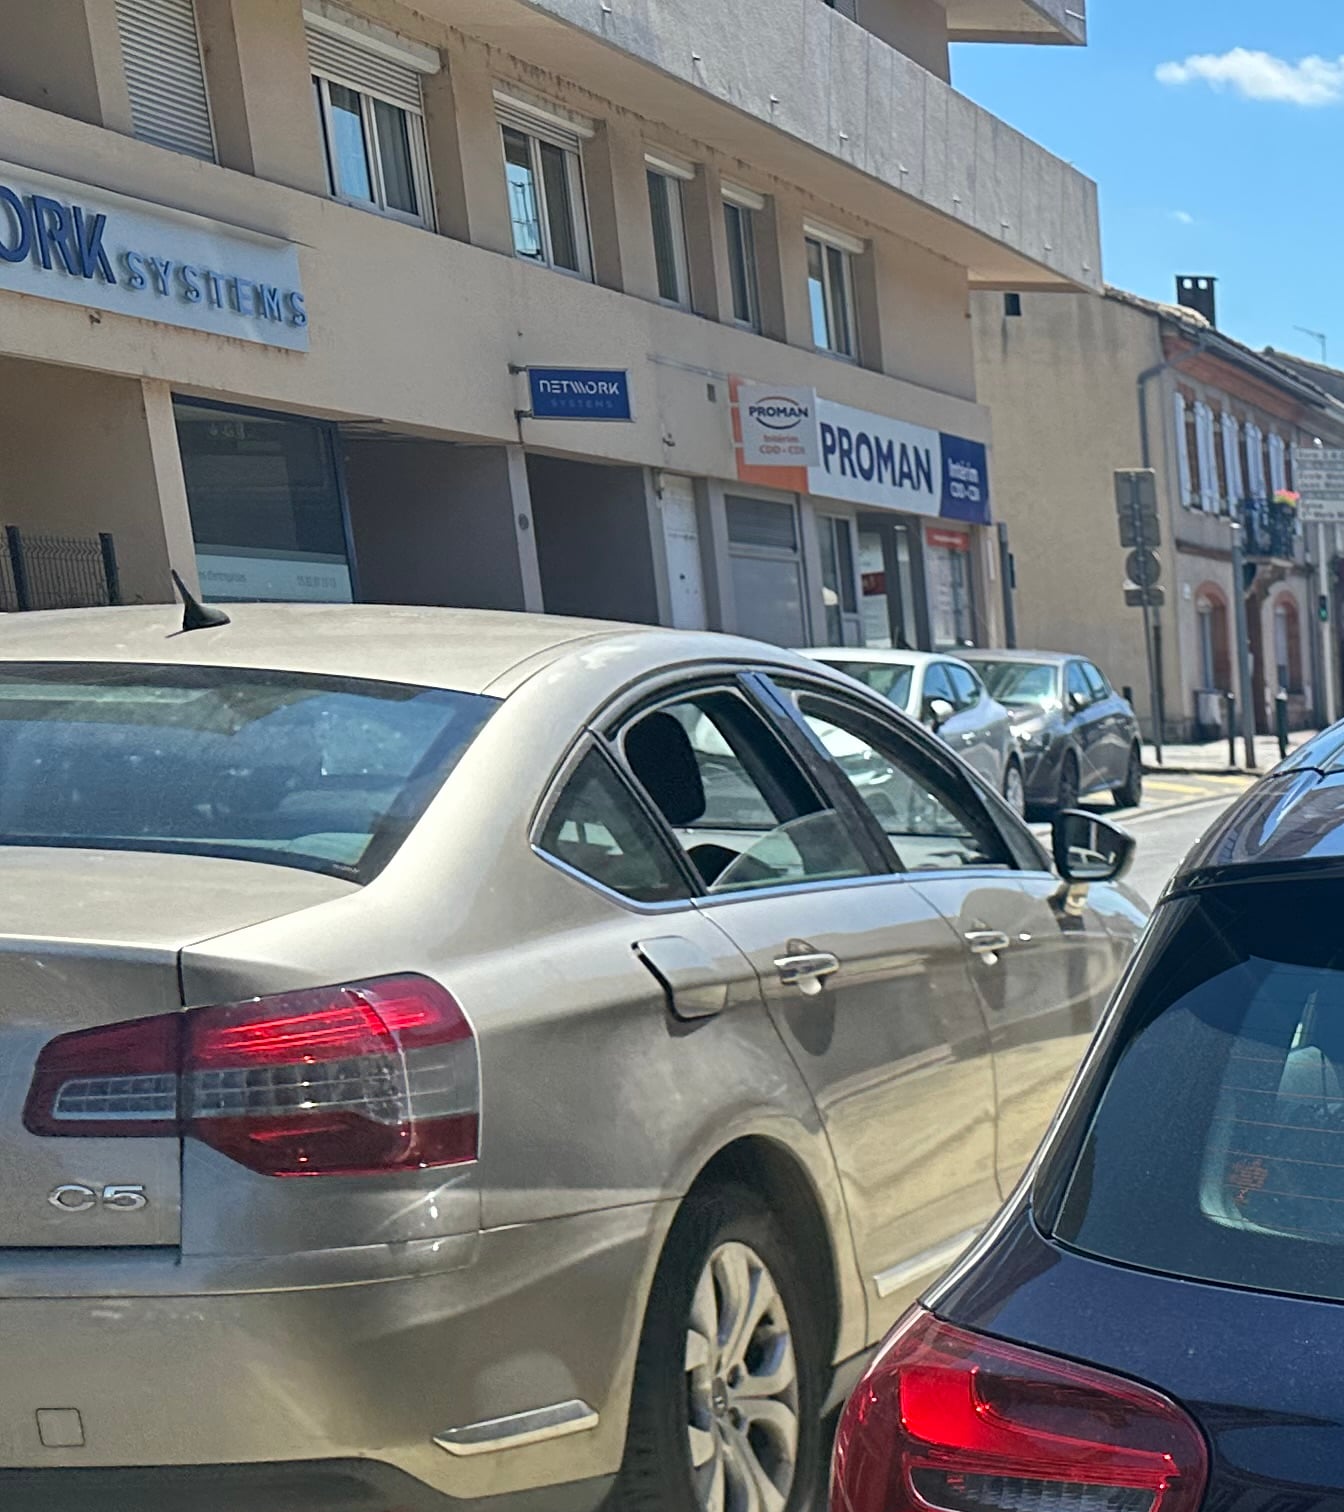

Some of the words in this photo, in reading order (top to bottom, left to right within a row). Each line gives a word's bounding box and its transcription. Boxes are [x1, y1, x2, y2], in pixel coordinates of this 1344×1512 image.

[119, 250, 308, 328] SYSTEMS
[539, 379, 620, 395] NETWORK
[748, 405, 809, 418] PROMAN
[819, 421, 934, 495] PROMAN
[47, 1184, 149, 1212] C5
